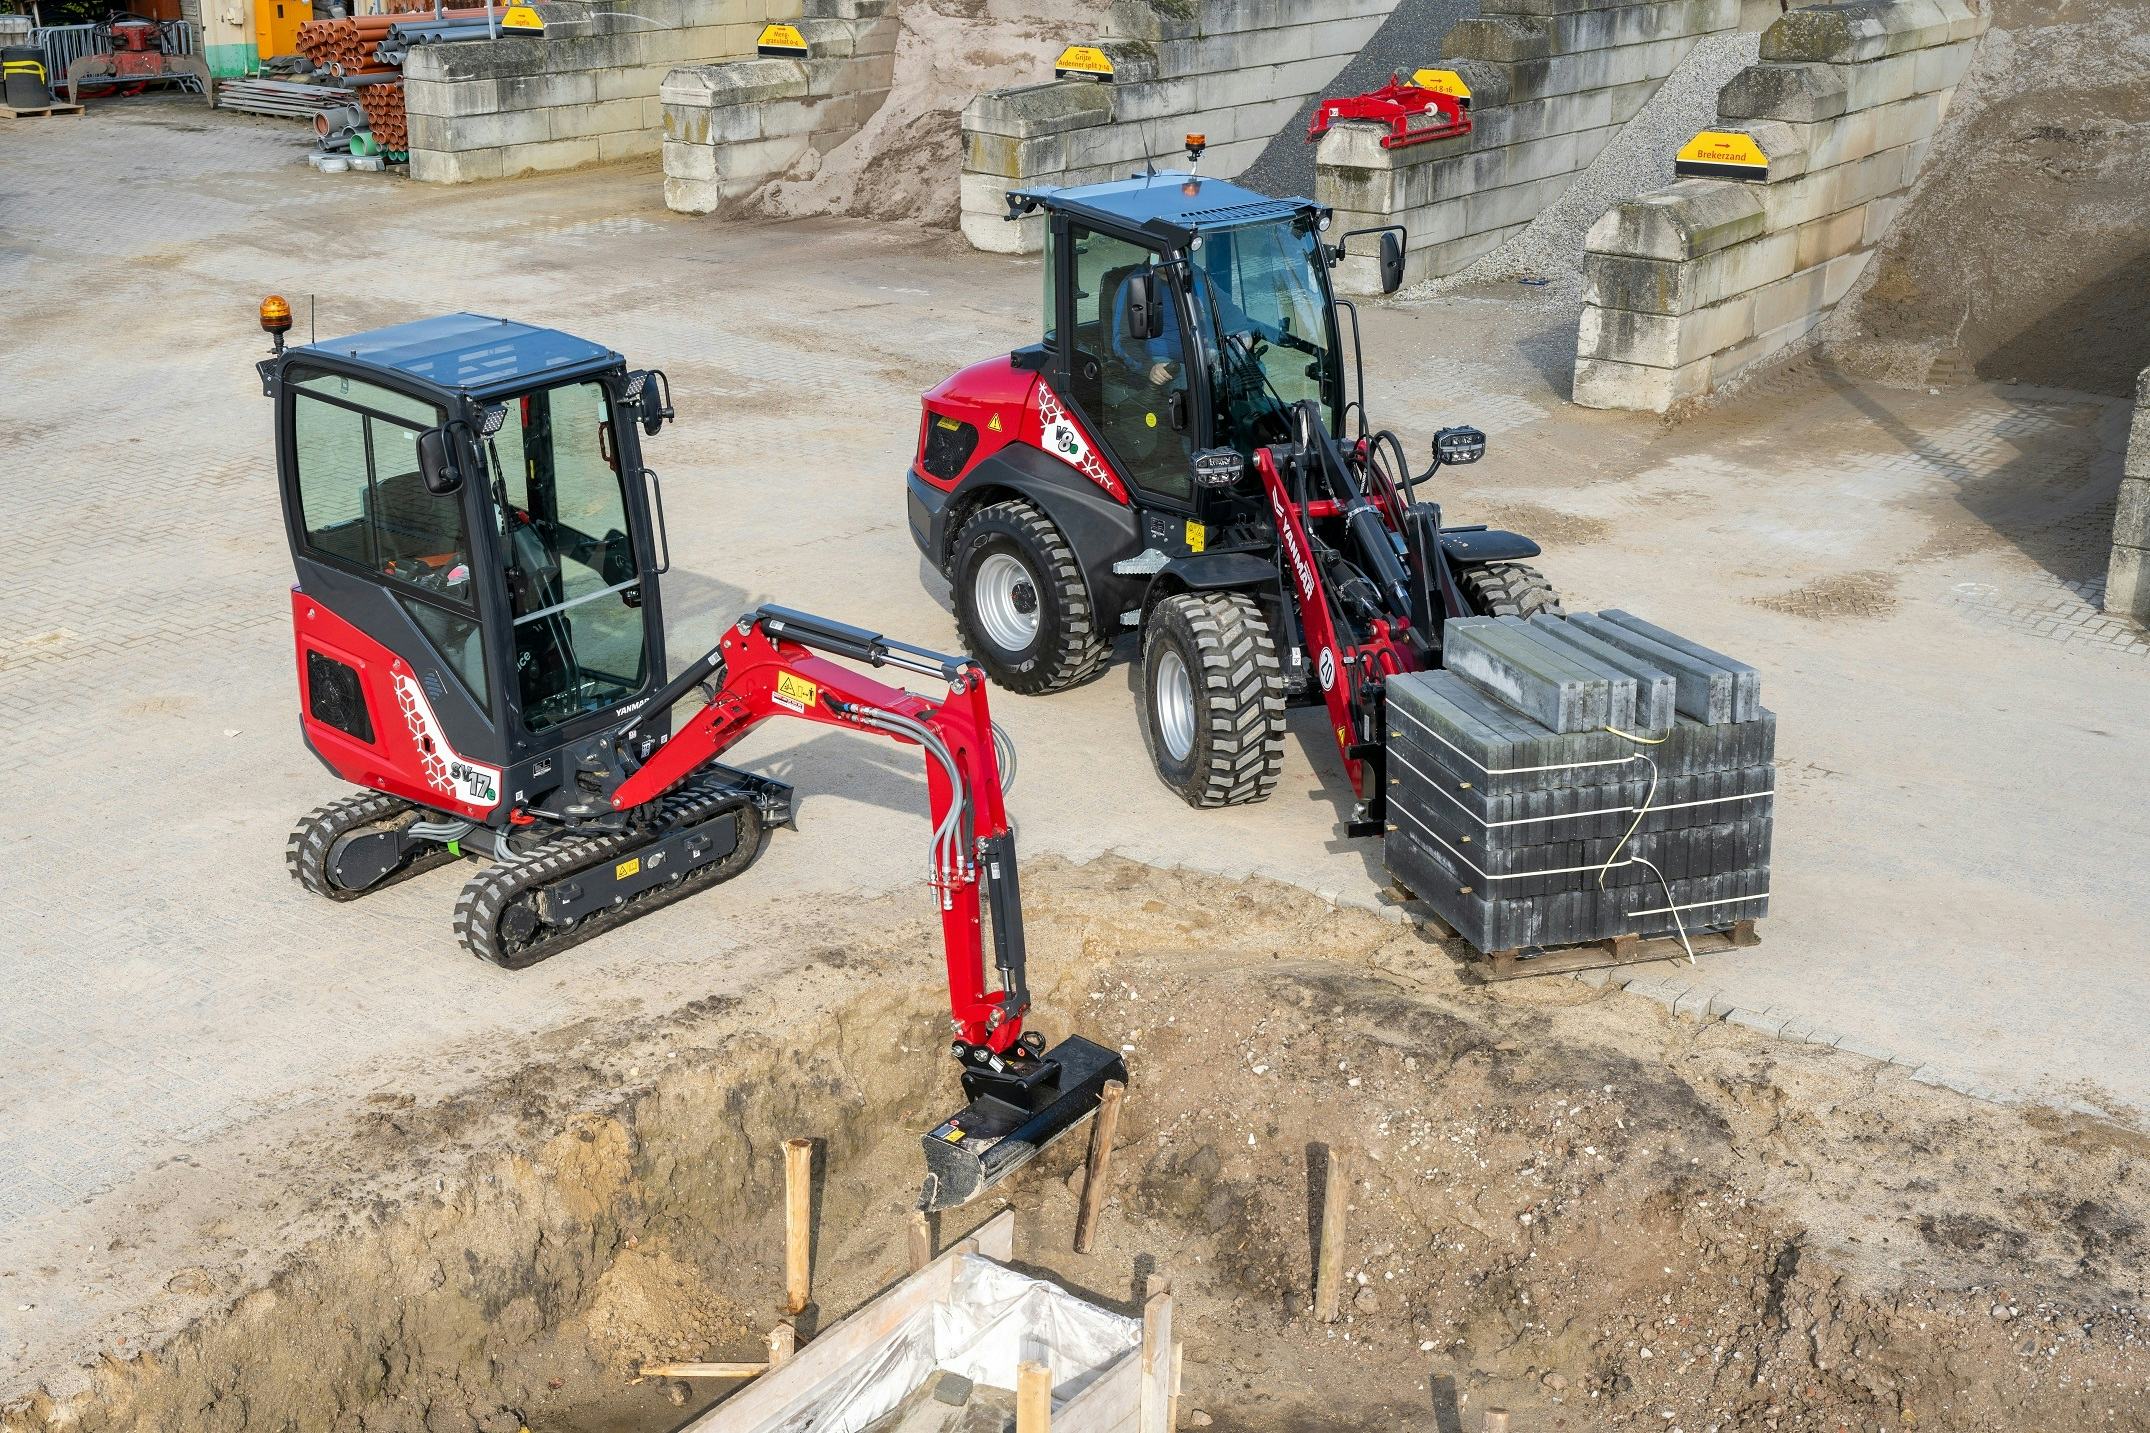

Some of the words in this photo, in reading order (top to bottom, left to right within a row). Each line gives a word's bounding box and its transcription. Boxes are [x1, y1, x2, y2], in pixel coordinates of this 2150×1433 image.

[1697, 149, 1747, 161] Brekerzand
[1283, 515, 1312, 602] YANMAR
[1320, 652, 1333, 685] 20
